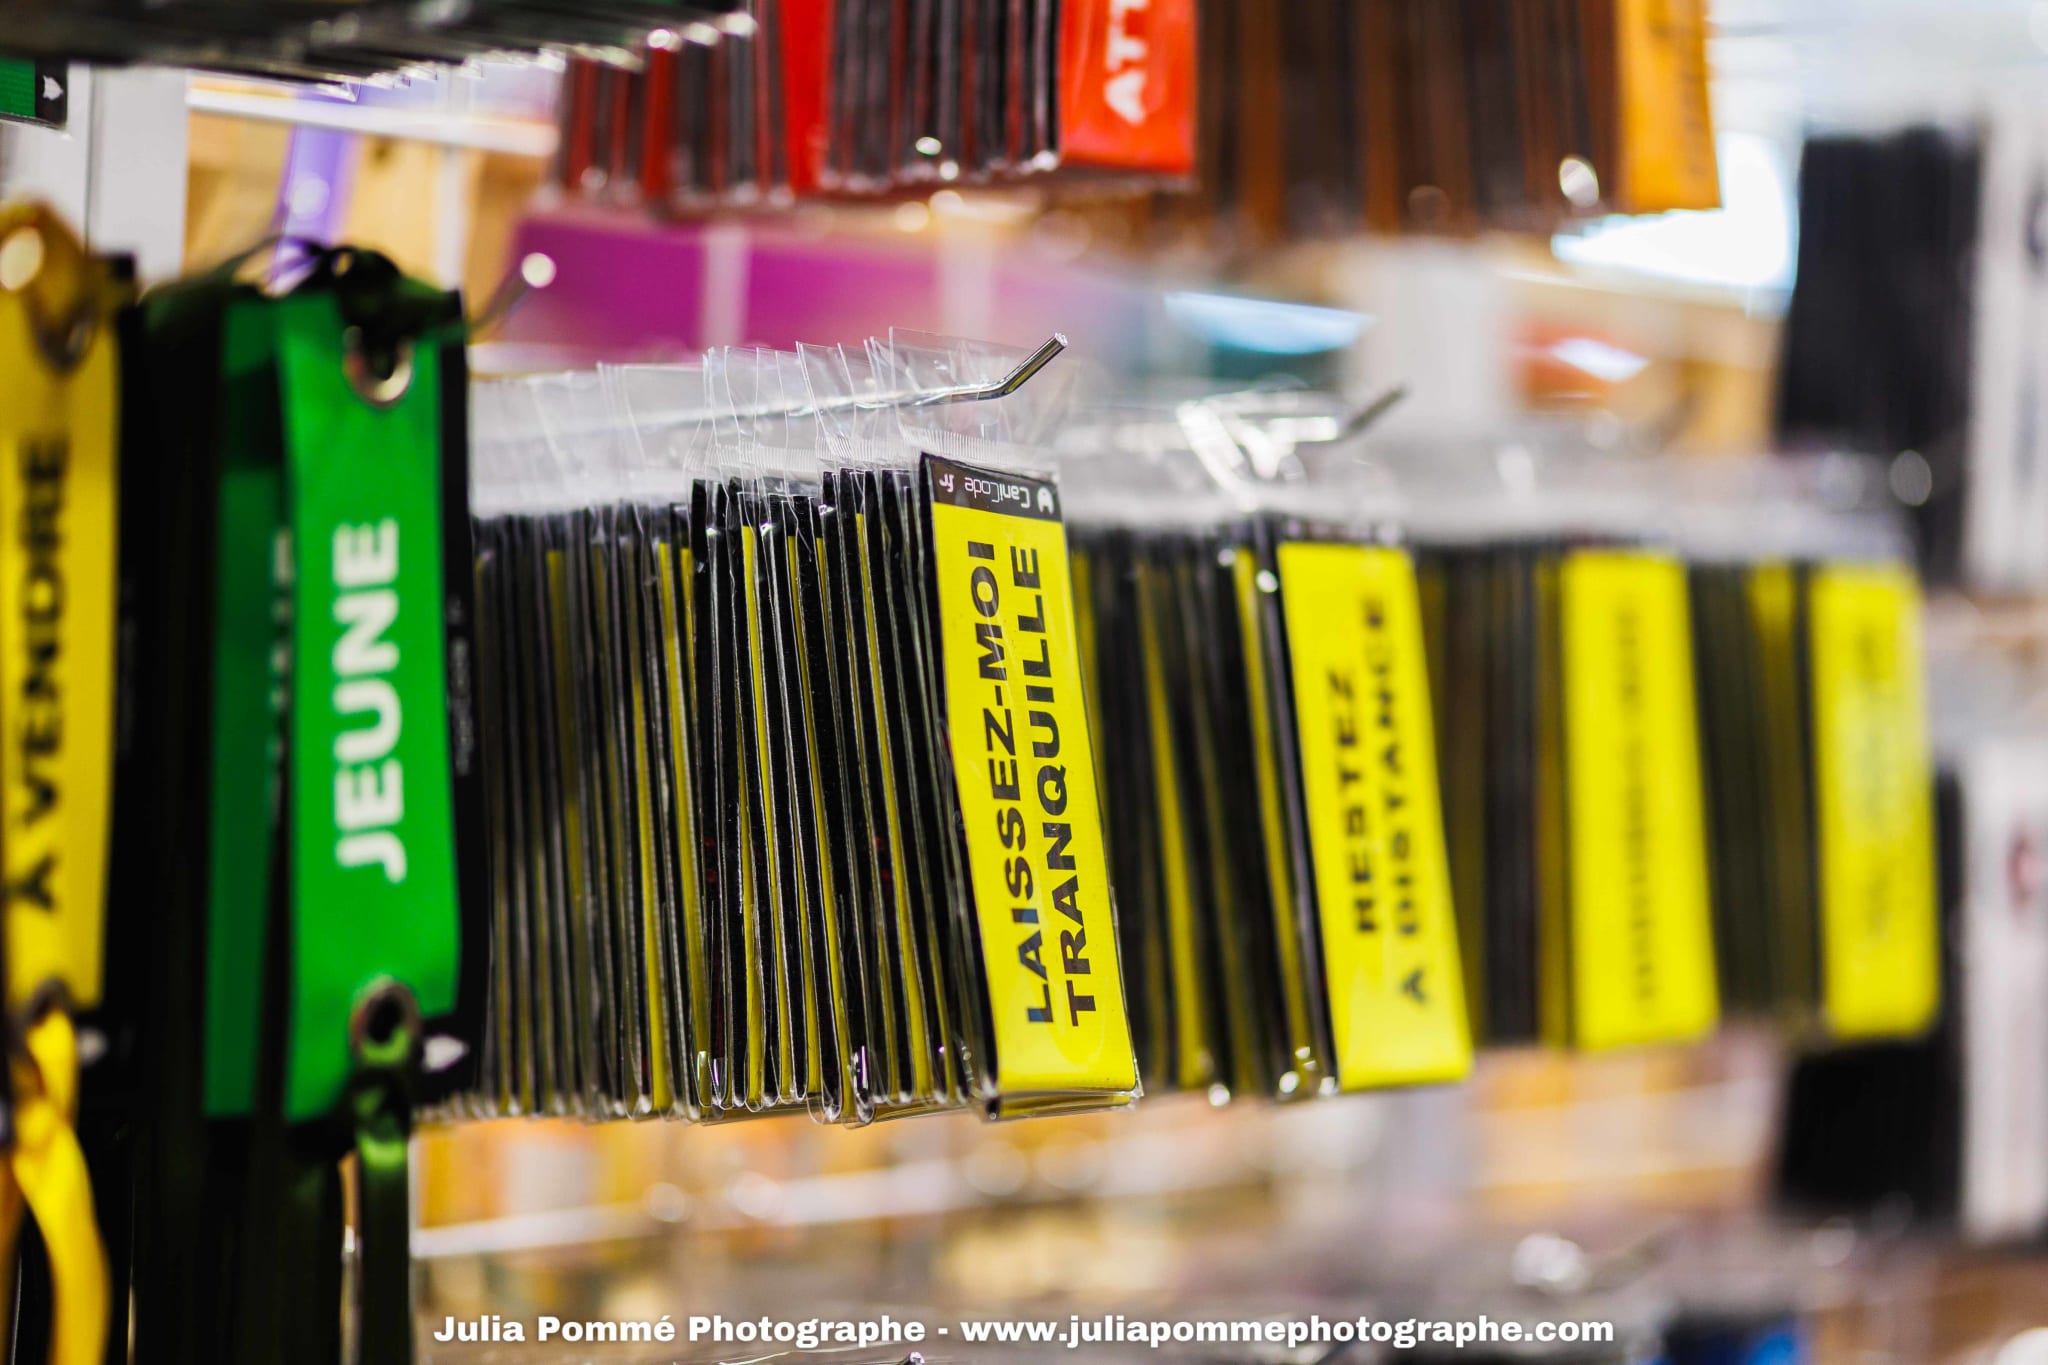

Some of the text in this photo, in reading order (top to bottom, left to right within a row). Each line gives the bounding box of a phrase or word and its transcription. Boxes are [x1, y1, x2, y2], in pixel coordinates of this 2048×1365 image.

[17, 436, 70, 828] VENDRE
[964, 476, 1031, 508] CaniCode
[332, 518, 407, 885] JEUNE
[968, 541, 1054, 1024] LAISSEZ-MOI
[1010, 545, 1097, 1027] TRANQUILLE
[1328, 667, 1380, 935] RESTEZ
[1363, 596, 1421, 937] DISTANCE
